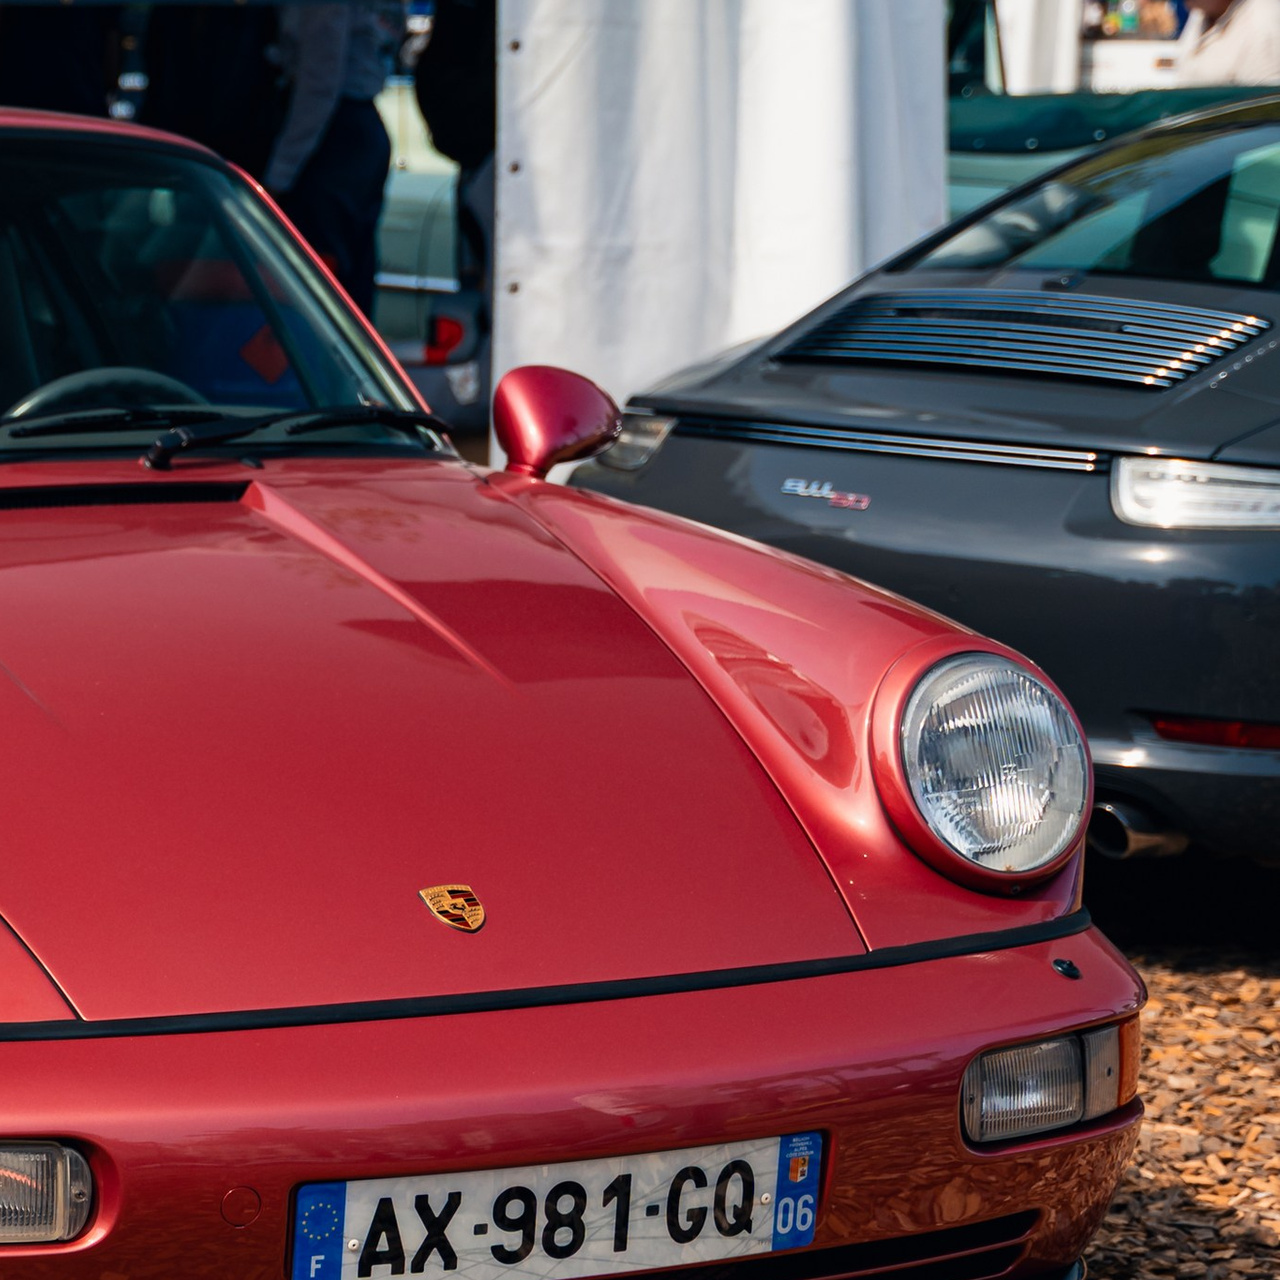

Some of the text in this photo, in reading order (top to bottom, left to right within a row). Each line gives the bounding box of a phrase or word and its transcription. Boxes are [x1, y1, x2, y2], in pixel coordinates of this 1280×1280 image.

[357, 1159, 755, 1278] AX-981-GQ
[776, 1194, 814, 1234] 06
[310, 1255, 325, 1277] F
